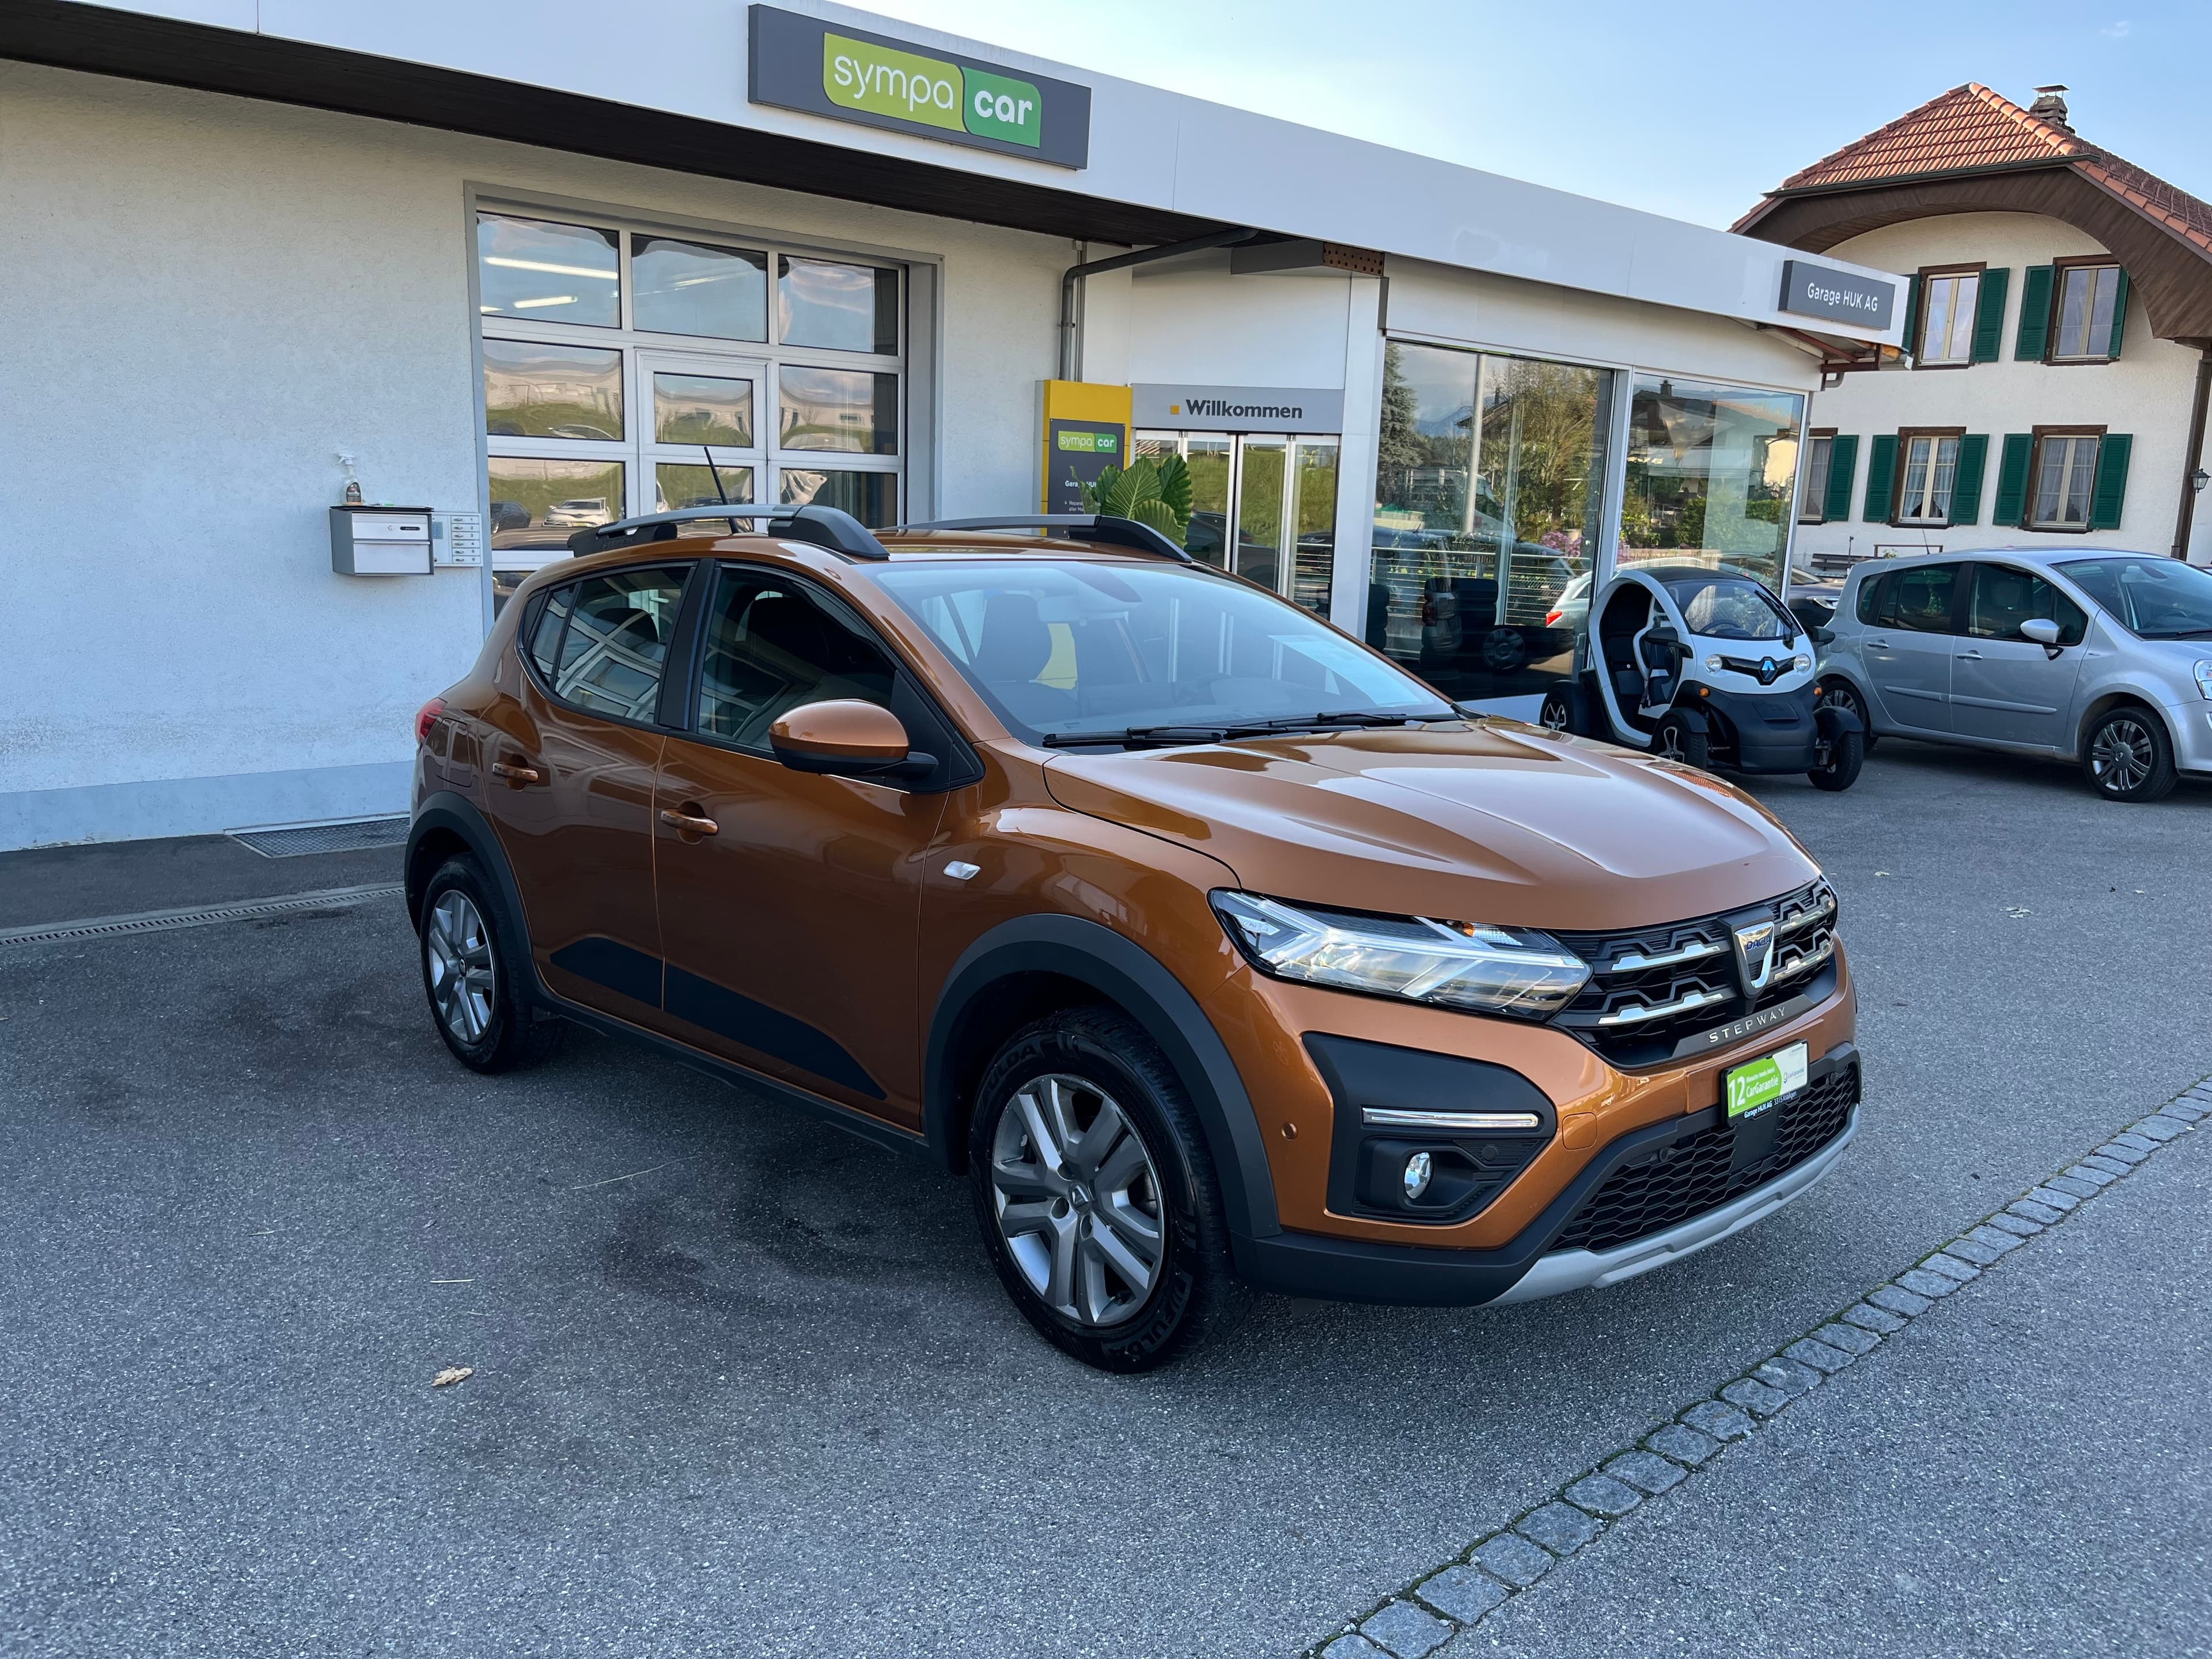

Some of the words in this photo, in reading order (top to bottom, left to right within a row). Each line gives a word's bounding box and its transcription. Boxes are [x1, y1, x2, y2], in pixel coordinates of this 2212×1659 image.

[834, 55, 953, 112] sympa
[974, 90, 1033, 126] car
[1807, 282, 1840, 306] Garage
[1843, 290, 1863, 309] HUK
[1864, 295, 1878, 312] AG
[1185, 399, 1303, 419] Willkommen
[1060, 435, 1093, 448] sympa
[1097, 438, 1115, 448] car
[1065, 480, 1080, 488] Gara
[1746, 935, 1772, 950] DACIA
[1709, 1006, 1786, 1043] STEPWAY
[1728, 1075, 1746, 1109] 12
[1746, 1076, 1779, 1098] CarGarantie
[1744, 1108, 1758, 1119] Garage
[1757, 1103, 1766, 1112] HUK
[1766, 1100, 1773, 1108] AG
